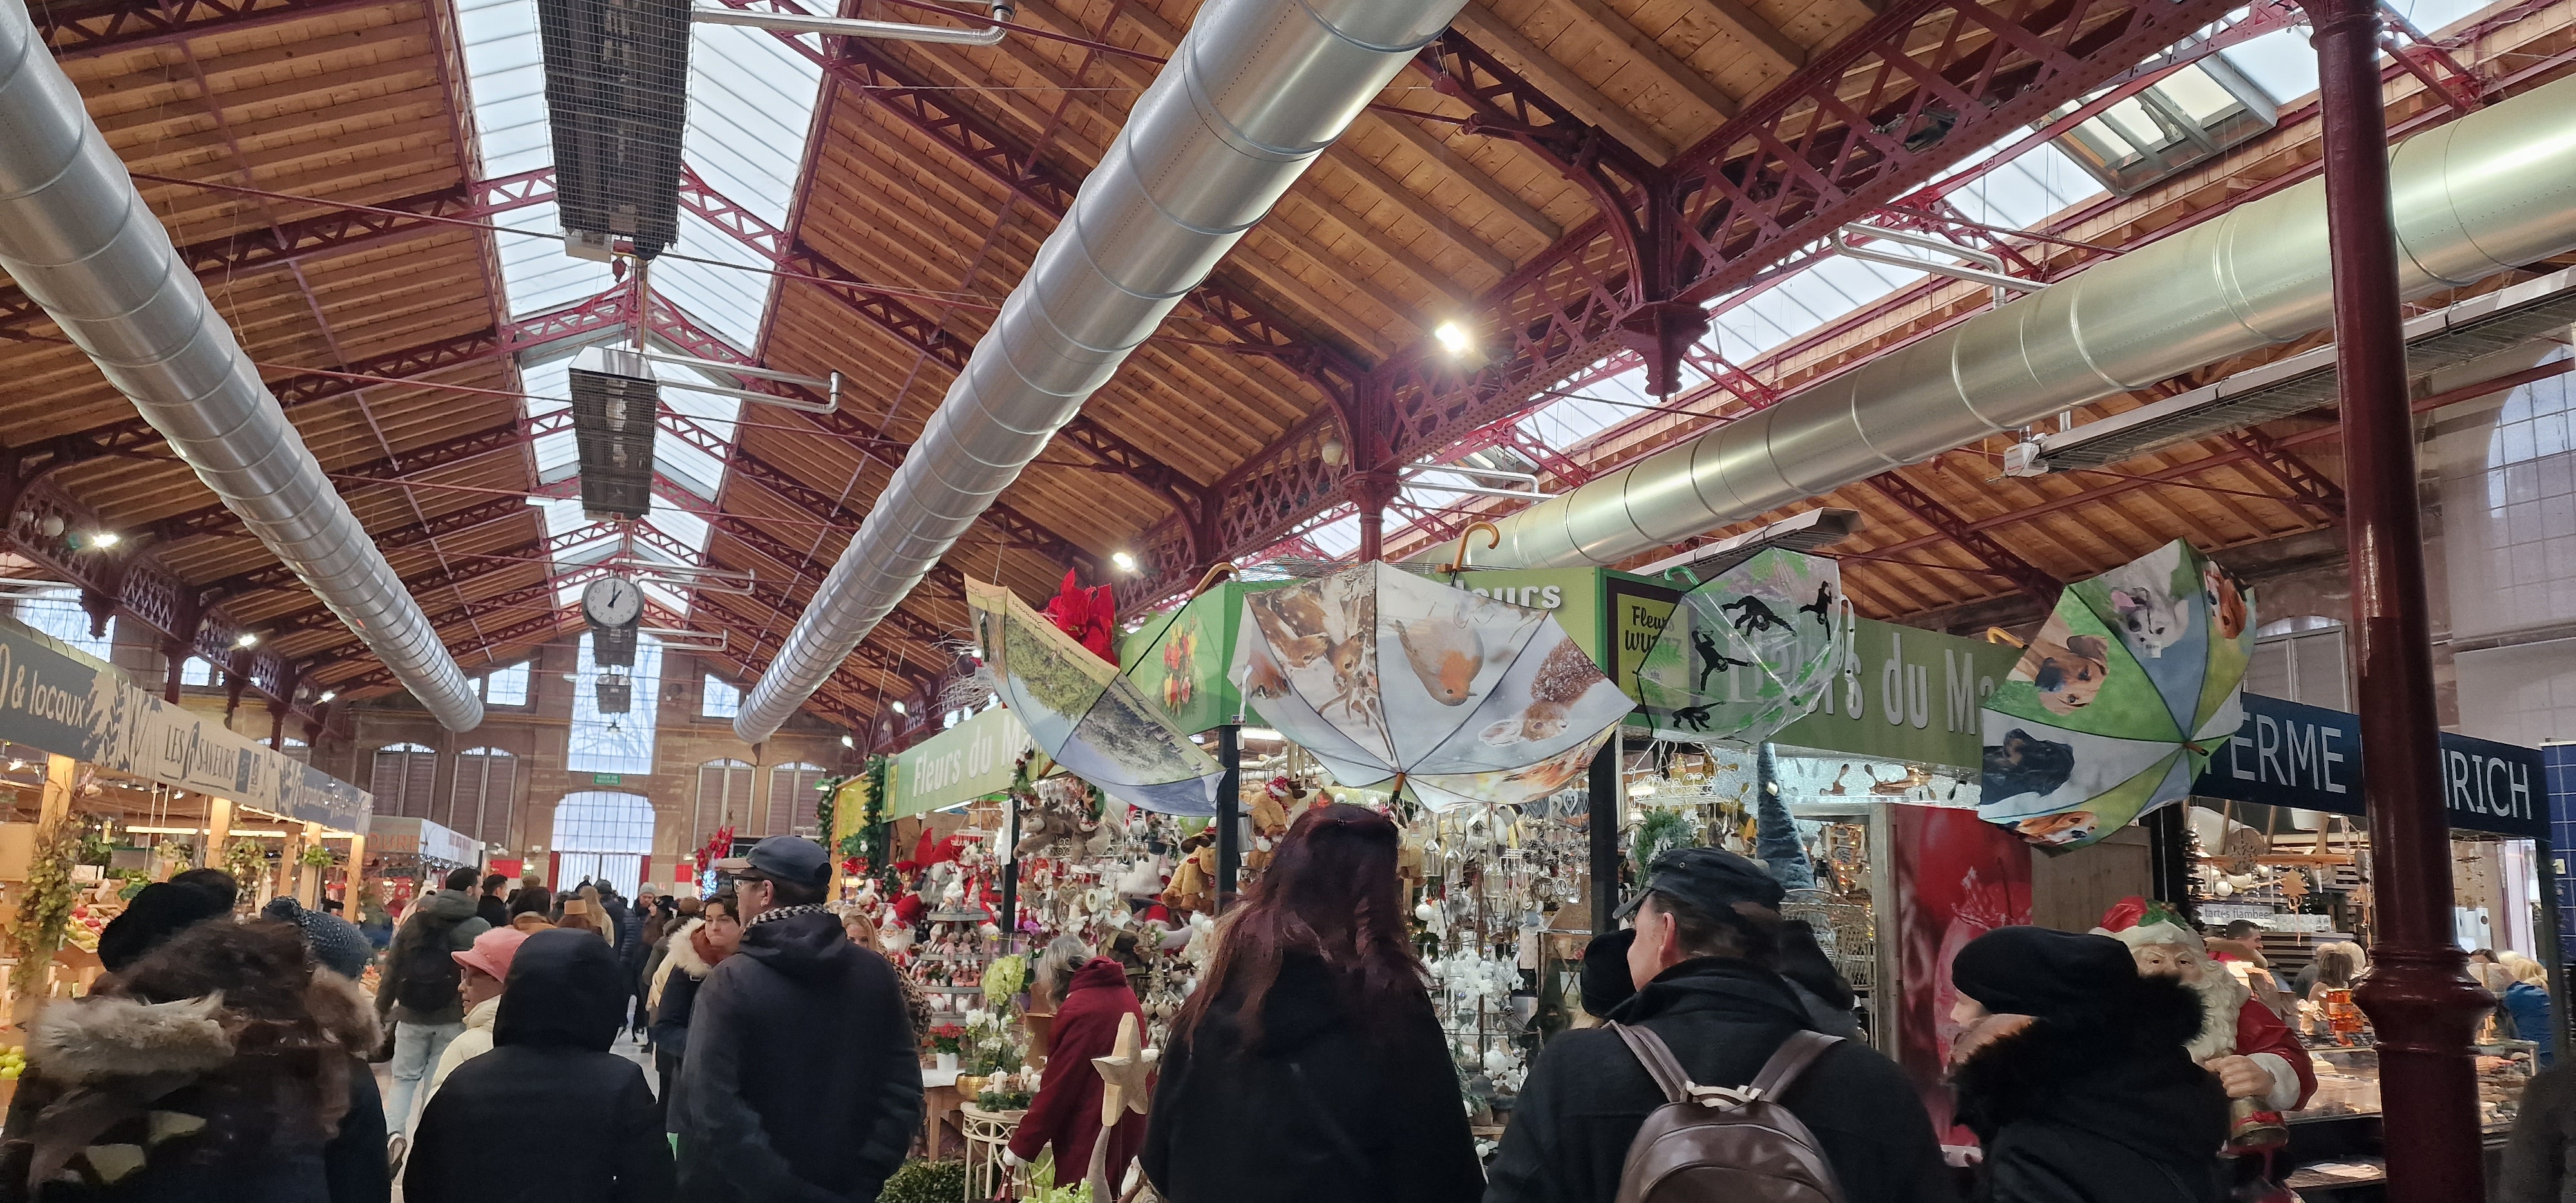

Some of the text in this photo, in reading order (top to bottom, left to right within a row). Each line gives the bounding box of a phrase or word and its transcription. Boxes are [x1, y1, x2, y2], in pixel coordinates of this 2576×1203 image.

[12, 665, 25, 709] &
[28, 670, 85, 728] locaux
[1882, 632, 1929, 730] du
[165, 725, 236, 781] LES SAVEURS
[913, 750, 961, 797] Fleurs
[968, 724, 992, 779] du
[2205, 711, 2347, 795] ERME
[2204, 908, 2230, 918] tartes
